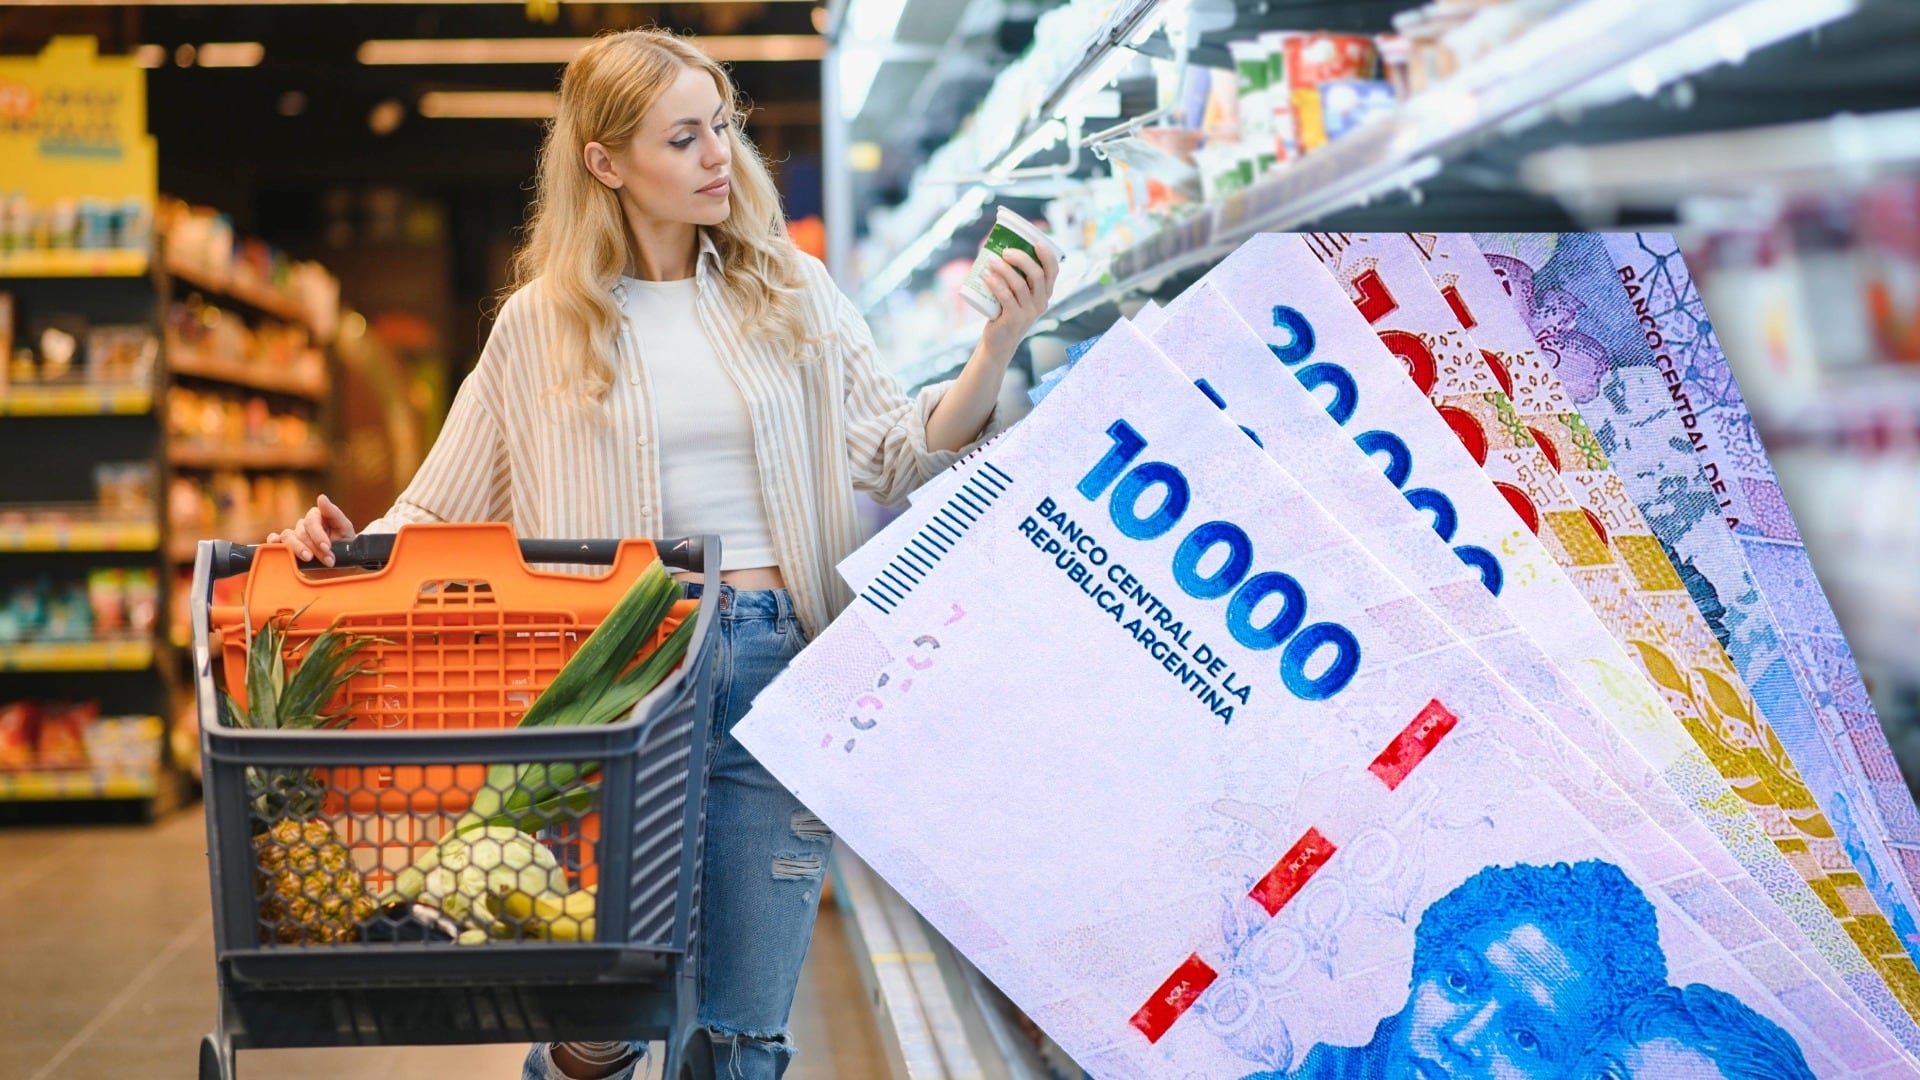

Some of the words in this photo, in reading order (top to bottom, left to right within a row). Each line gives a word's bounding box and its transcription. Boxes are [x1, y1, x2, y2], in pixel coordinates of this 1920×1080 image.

[1617, 265, 1662, 350] BANCO
[1018, 516, 1127, 623] REPÚBLICA
[1123, 619, 1236, 726] ARGENTINA
[1036, 496, 1109, 567] BANCO
[1107, 564, 1194, 651] CENTRAL
[1192, 643, 1229, 678] DE
[1221, 672, 1252, 706] LA
